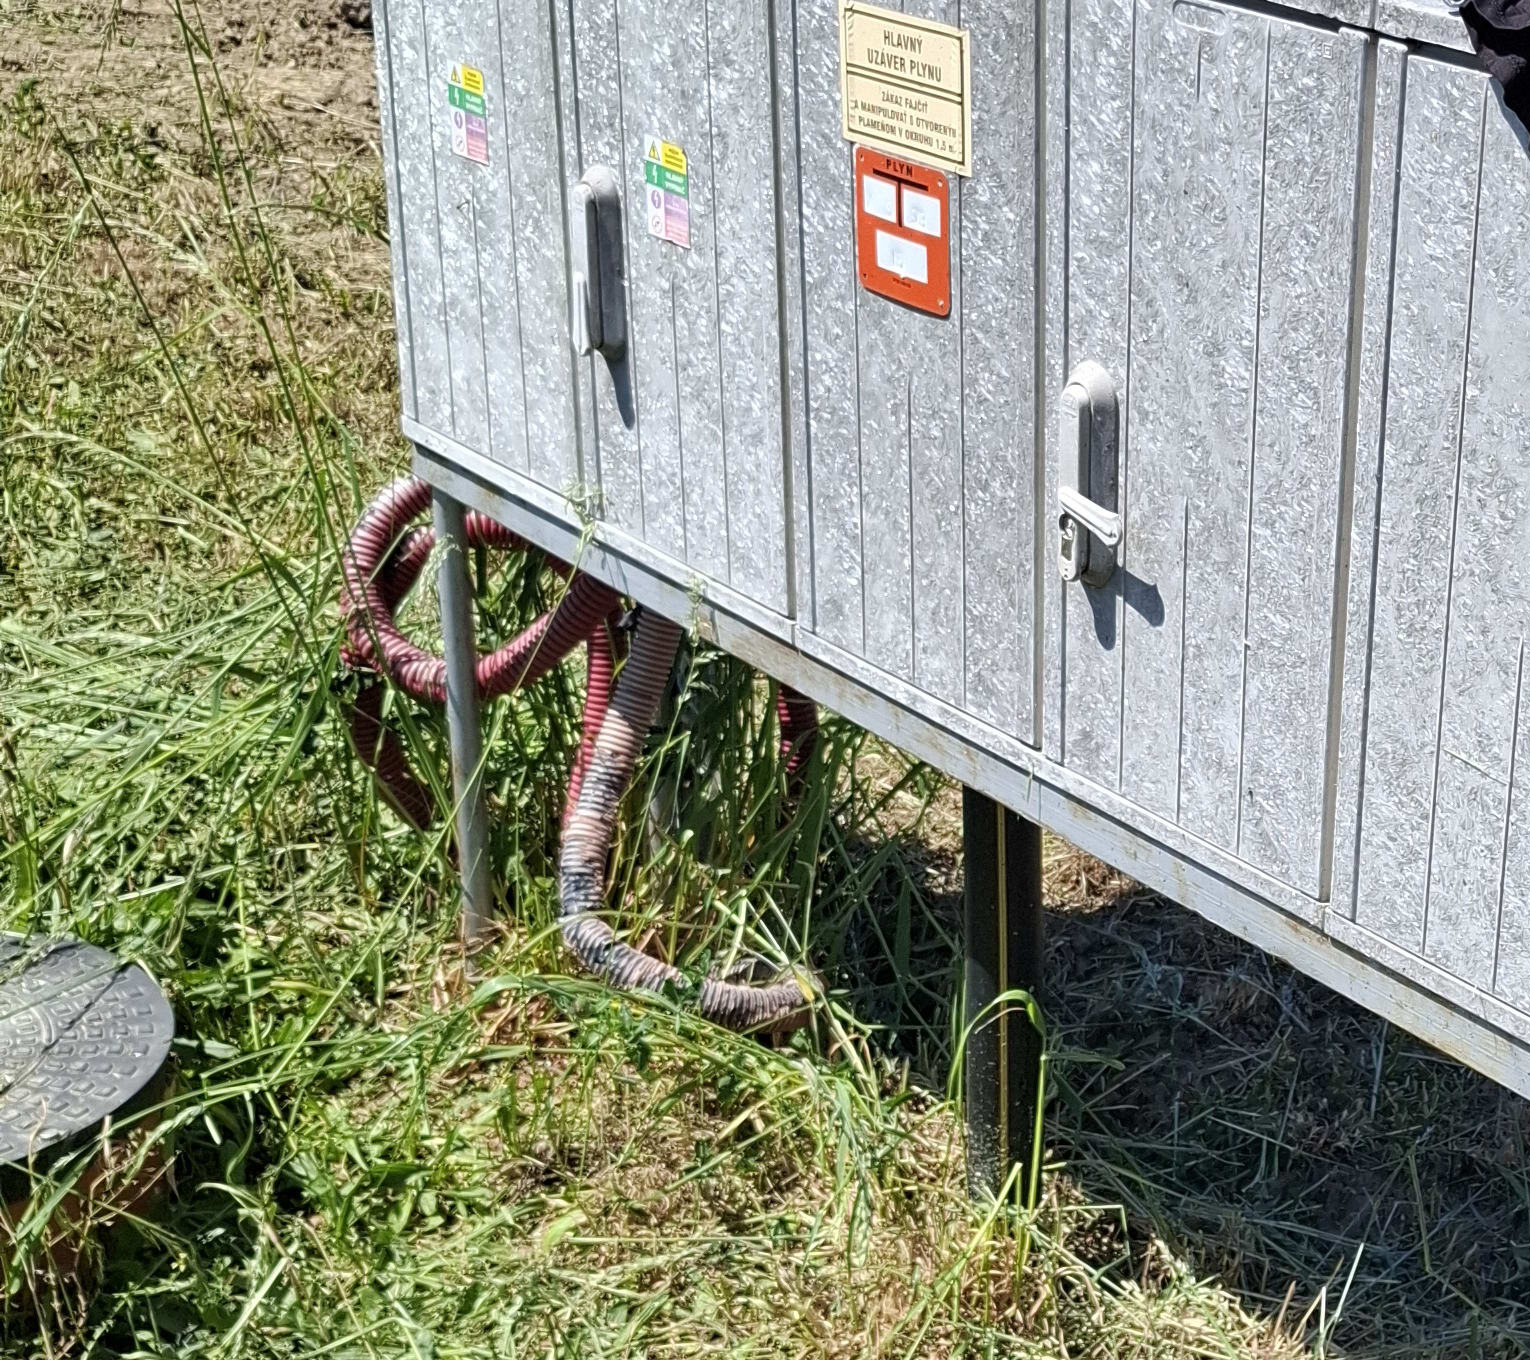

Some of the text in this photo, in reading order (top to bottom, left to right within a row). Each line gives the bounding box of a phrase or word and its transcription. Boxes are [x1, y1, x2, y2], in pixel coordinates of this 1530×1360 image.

[883, 29, 923, 55] HLAVNÝ
[867, 48, 942, 83] UZÁVER PLYNU
[860, 100, 907, 123] MANIPULOVAŤ
[881, 90, 928, 115] ZÁKAZ FAJČIŤ
[858, 115, 897, 137] PLAMEŇOM
[898, 127, 903, 138] V
[885, 158, 914, 178] PLYN
